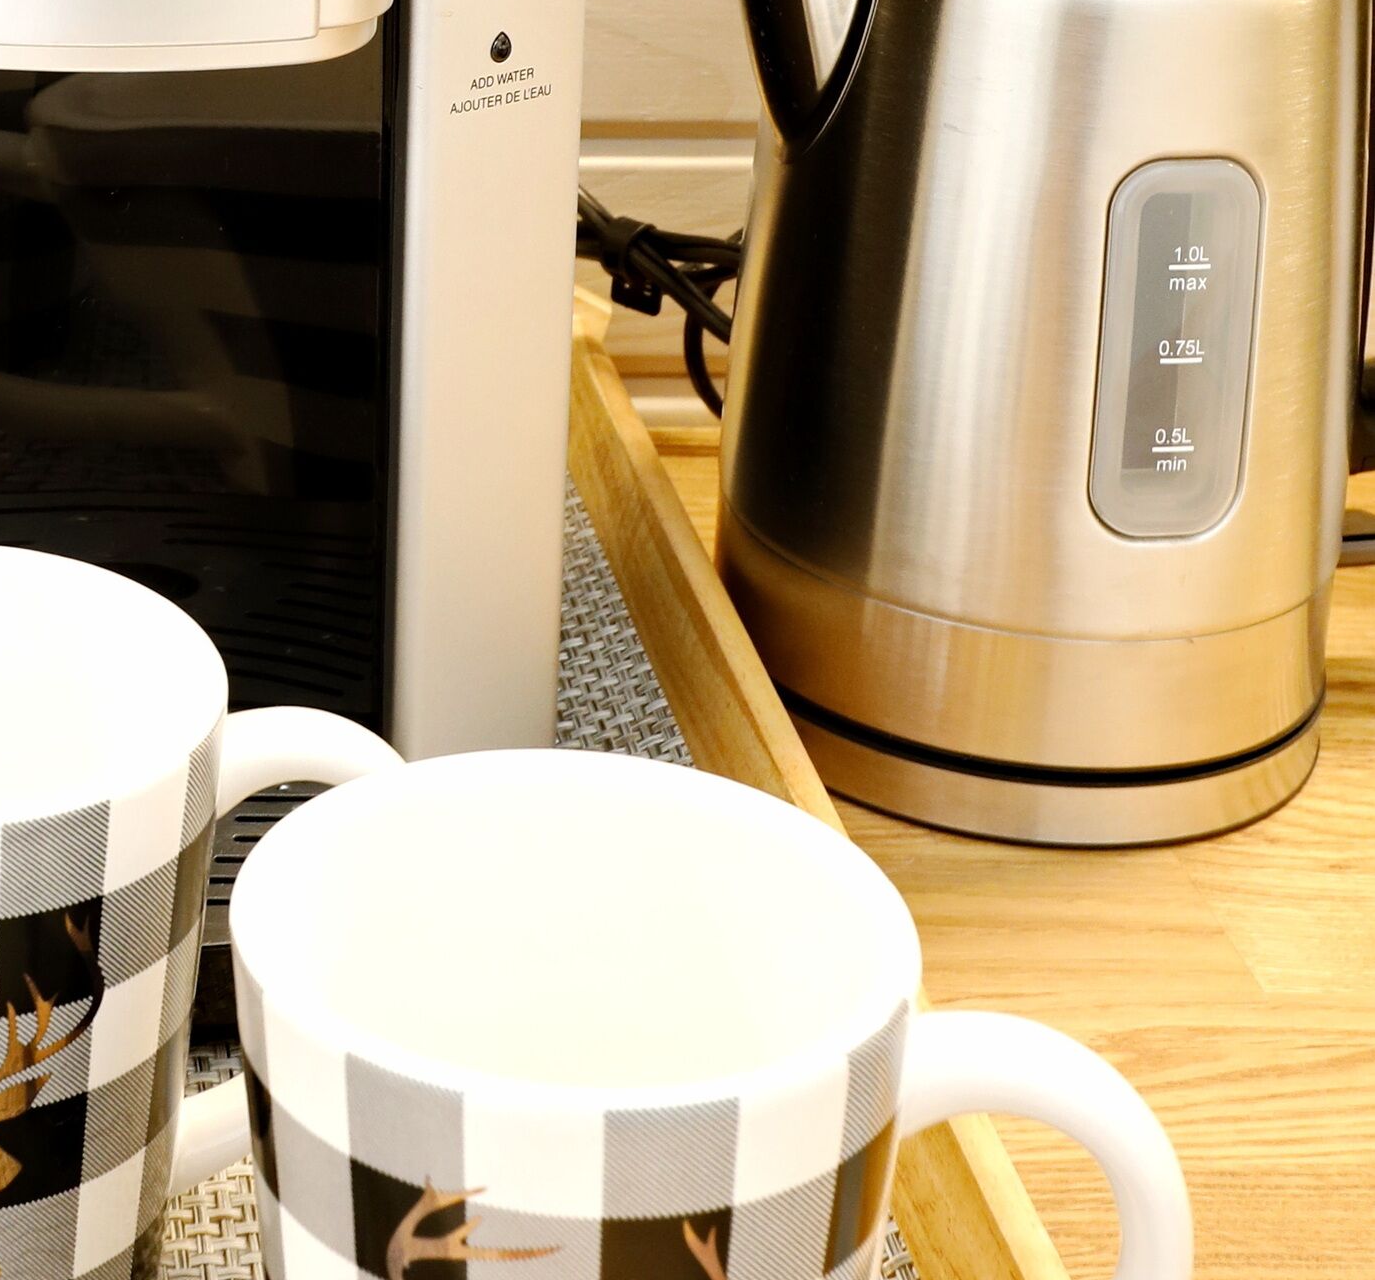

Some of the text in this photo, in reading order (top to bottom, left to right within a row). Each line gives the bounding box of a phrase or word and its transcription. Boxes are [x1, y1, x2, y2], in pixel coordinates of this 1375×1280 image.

[470, 67, 535, 91] ADD WATER
[449, 84, 552, 115] AJOUTER DE L'EAU
[1174, 245, 1210, 263] 1.0L
[1169, 276, 1208, 291] max
[1158, 338, 1205, 357] 0.75L
[1155, 427, 1192, 445] 0.5L
[1156, 455, 1187, 472] min
